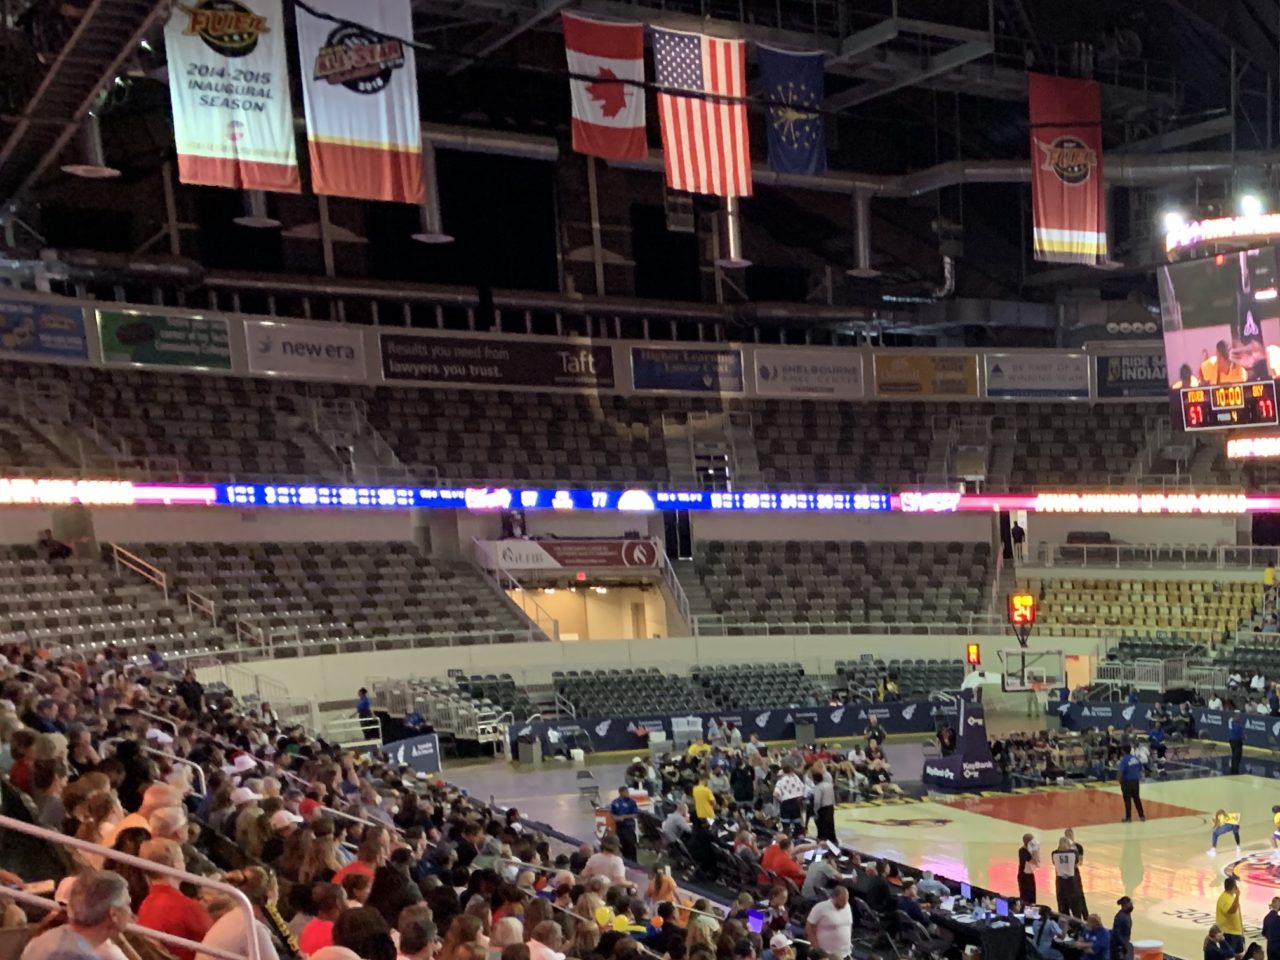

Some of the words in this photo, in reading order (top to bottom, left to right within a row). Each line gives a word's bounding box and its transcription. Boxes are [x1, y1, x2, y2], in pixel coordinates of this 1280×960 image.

[187, 63, 271, 85] 2014-2015
[188, 79, 273, 99] INAUGURAL
[200, 95, 265, 112] SEASON
[388, 340, 428, 354] Results
[431, 343, 451, 358] you
[484, 344, 510, 359] from
[389, 358, 439, 375] lawyers
[442, 362, 466, 376] you
[469, 363, 503, 376] trust.
[557, 349, 595, 373] Taft
[1122, 356, 1149, 368] RIDE
[1216, 387, 1241, 407] 10:00
[1252, 385, 1264, 397] SKY
[1189, 405, 1203, 424] 57
[1231, 410, 1238, 423] 4
[1259, 400, 1273, 418] 77
[1014, 605, 1031, 621] 24
[963, 761, 993, 770] KeyBank
